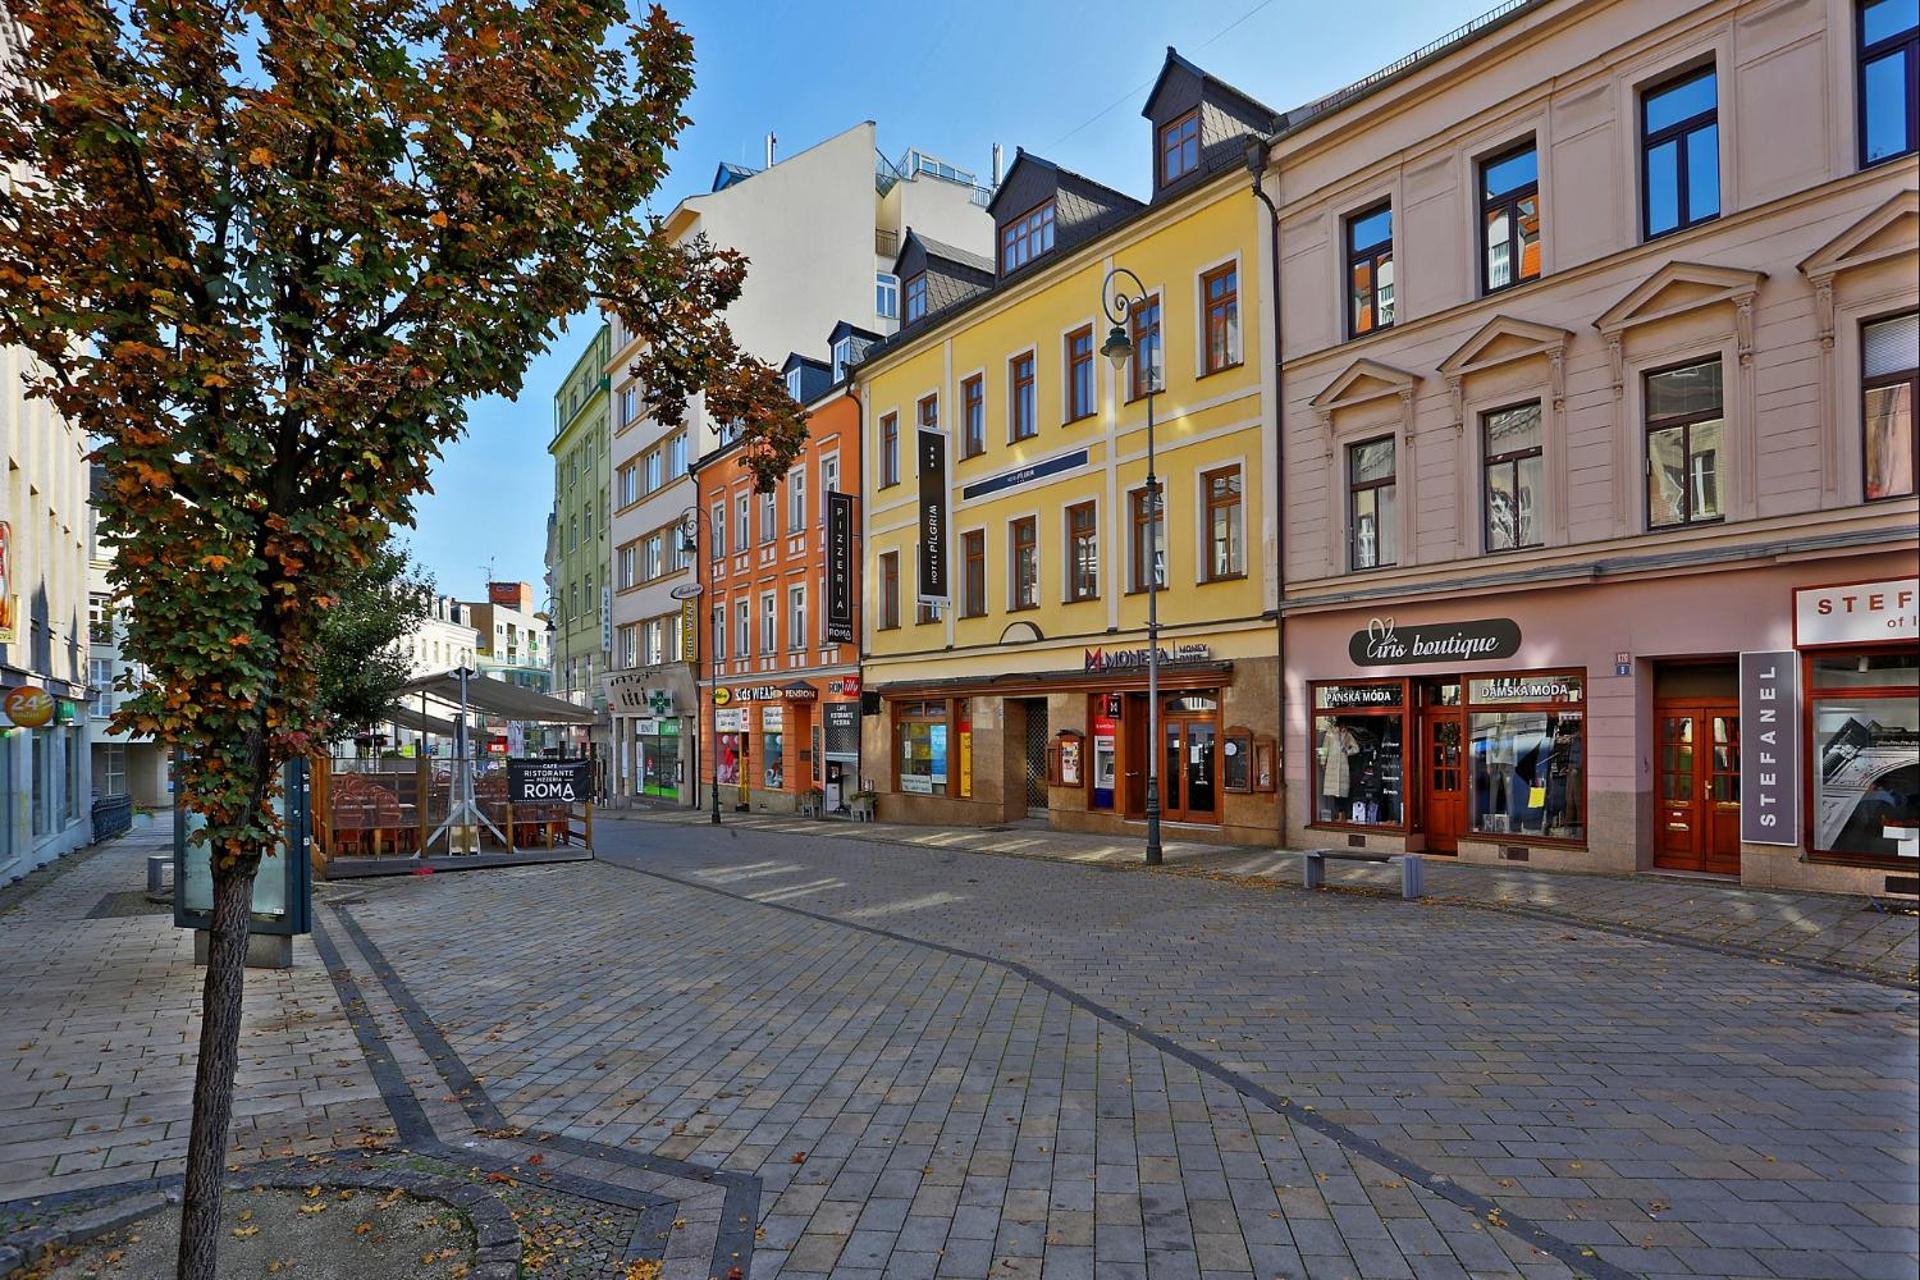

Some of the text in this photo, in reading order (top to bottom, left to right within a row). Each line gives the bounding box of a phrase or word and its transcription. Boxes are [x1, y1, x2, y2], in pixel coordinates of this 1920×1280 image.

[836, 507, 844, 609] PIZZERIA
[1817, 591, 1913, 615] STEF
[1887, 616, 1904, 628] of
[828, 627, 851, 641] ROMA
[1412, 631, 1500, 660] boutique
[1104, 647, 1170, 668] MONEA
[11, 694, 38, 712] 24
[785, 689, 815, 699] PENSION
[1759, 666, 1777, 828] STEFANEL
[524, 769, 575, 777] RISTORANTE
[524, 782, 576, 802] ROMA
